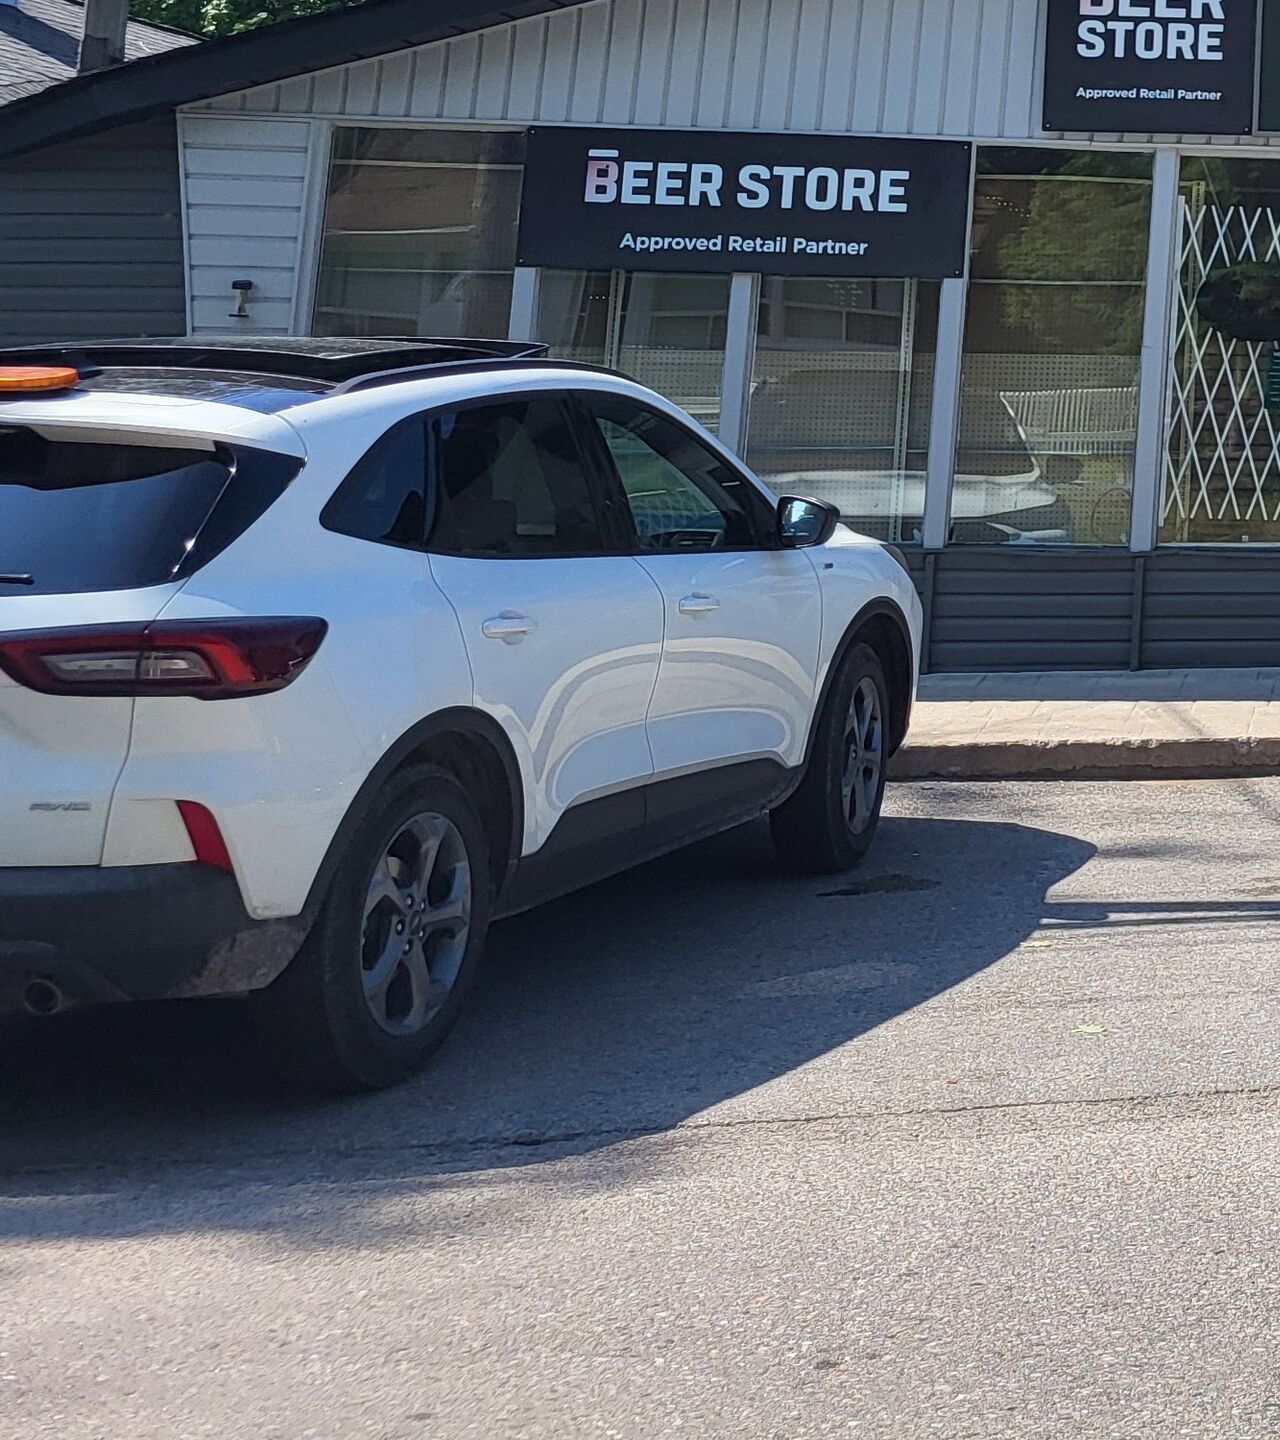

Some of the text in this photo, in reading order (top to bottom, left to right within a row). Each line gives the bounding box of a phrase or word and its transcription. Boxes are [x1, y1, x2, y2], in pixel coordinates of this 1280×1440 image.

[1076, 19, 1225, 61] STORE
[1075, 86, 1223, 101] Approved Retail Partner
[584, 149, 910, 213] BEER STORE
[619, 232, 869, 255] Approved Retail Partner
